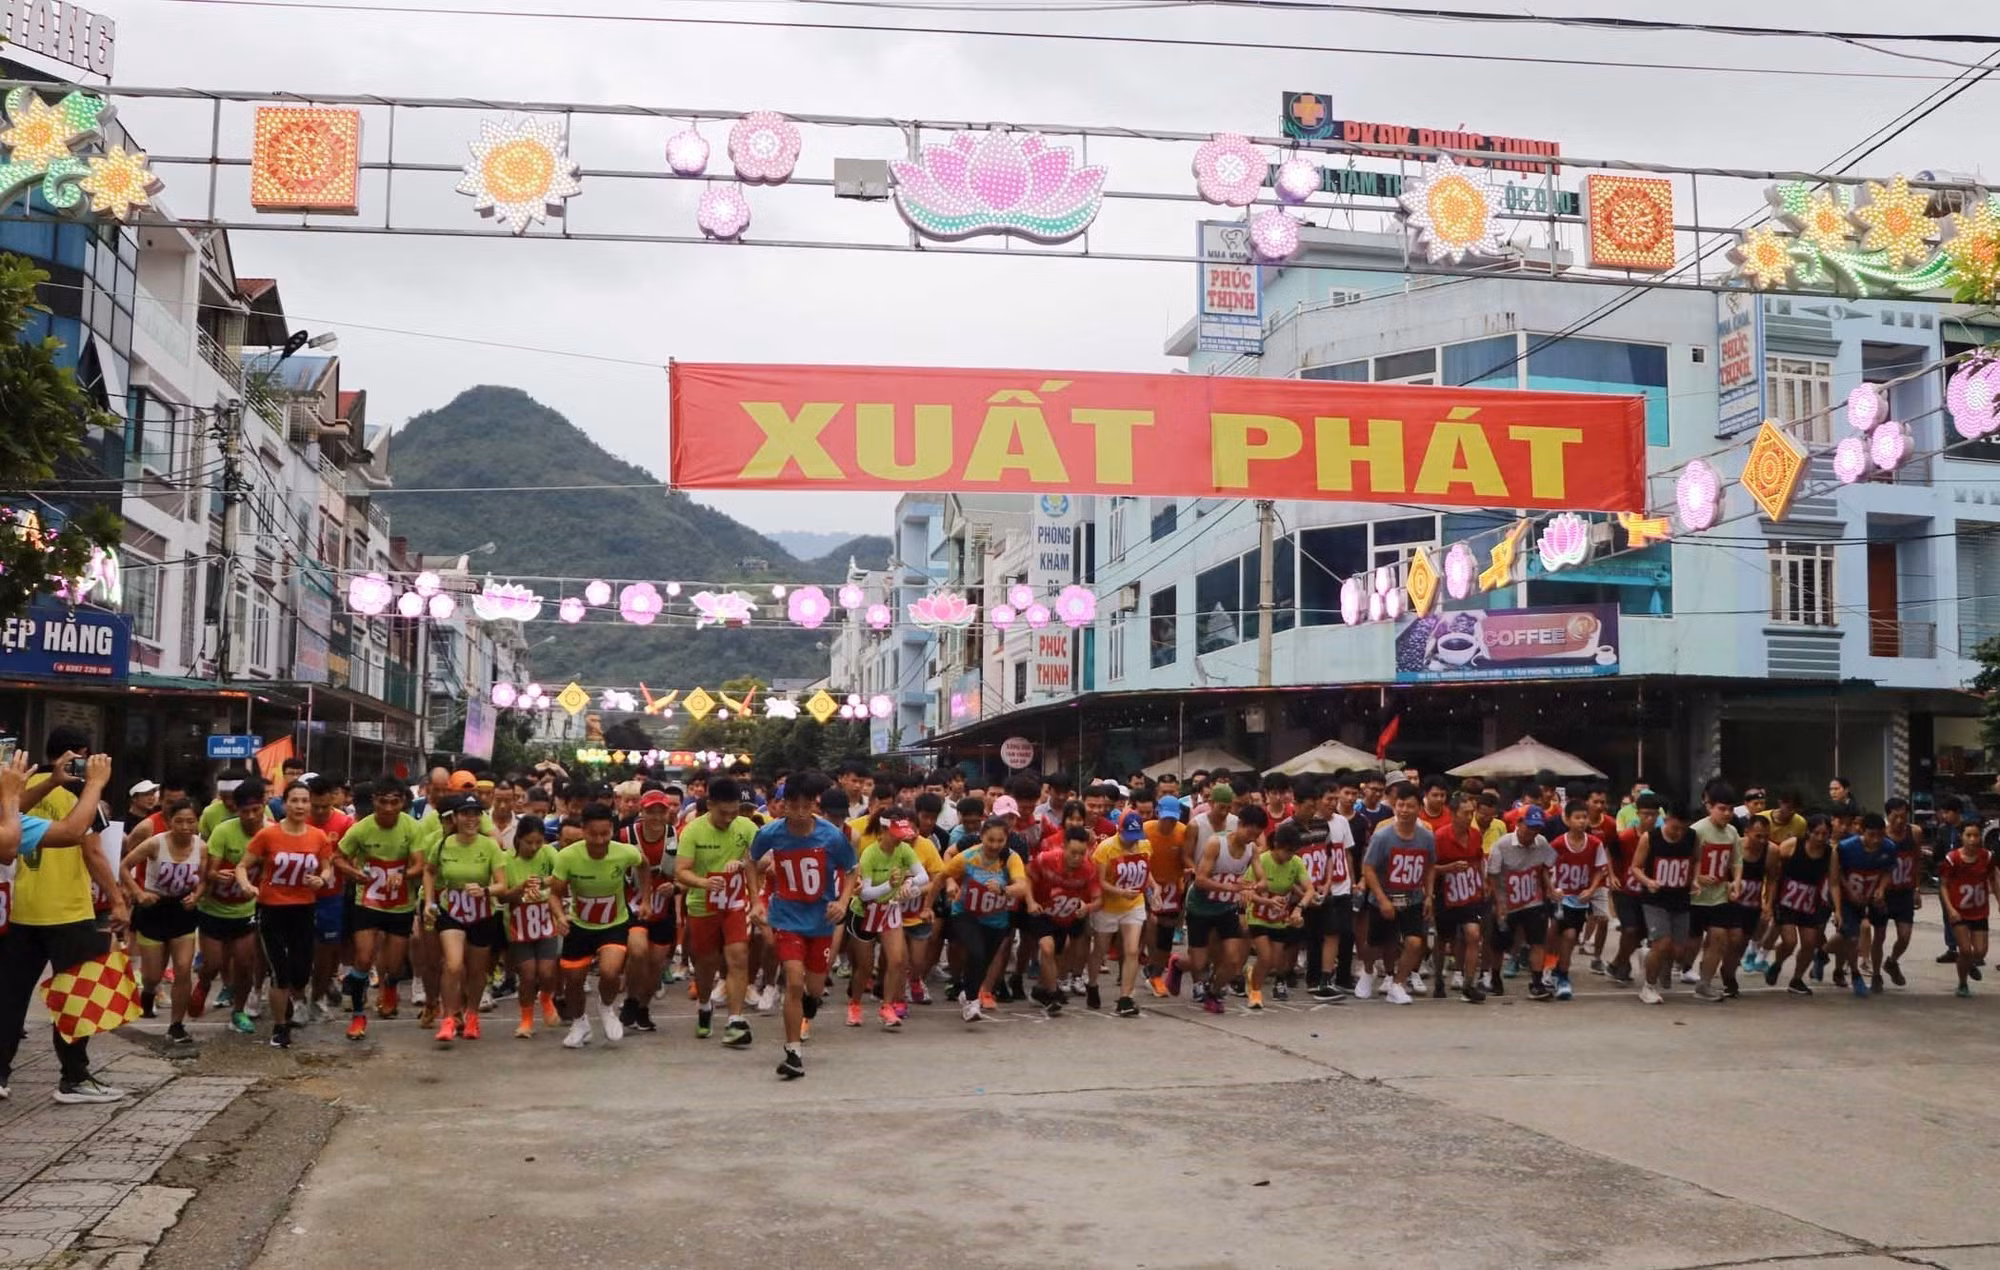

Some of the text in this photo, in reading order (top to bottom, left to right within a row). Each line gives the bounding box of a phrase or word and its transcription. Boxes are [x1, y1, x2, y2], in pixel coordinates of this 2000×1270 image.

[1490, 135, 1560, 180] THỊNH
[1210, 266, 1251, 289] PHÚC
[1207, 290, 1255, 312] THỊNH
[1721, 331, 1750, 361] PHÚC
[1719, 356, 1752, 385] THỊNH
[738, 380, 1584, 500] XUẤT PHÁT
[1039, 630, 1068, 659] PHÚC
[1484, 627, 1568, 648] COFFEE
[159, 862, 200, 897] 285
[780, 856, 820, 897] 16
[1116, 859, 1148, 891] 296
[1389, 853, 1425, 885] 256
[1656, 858, 1690, 887] 003
[513, 903, 554, 941] 185
[577, 896, 616, 924] 77
